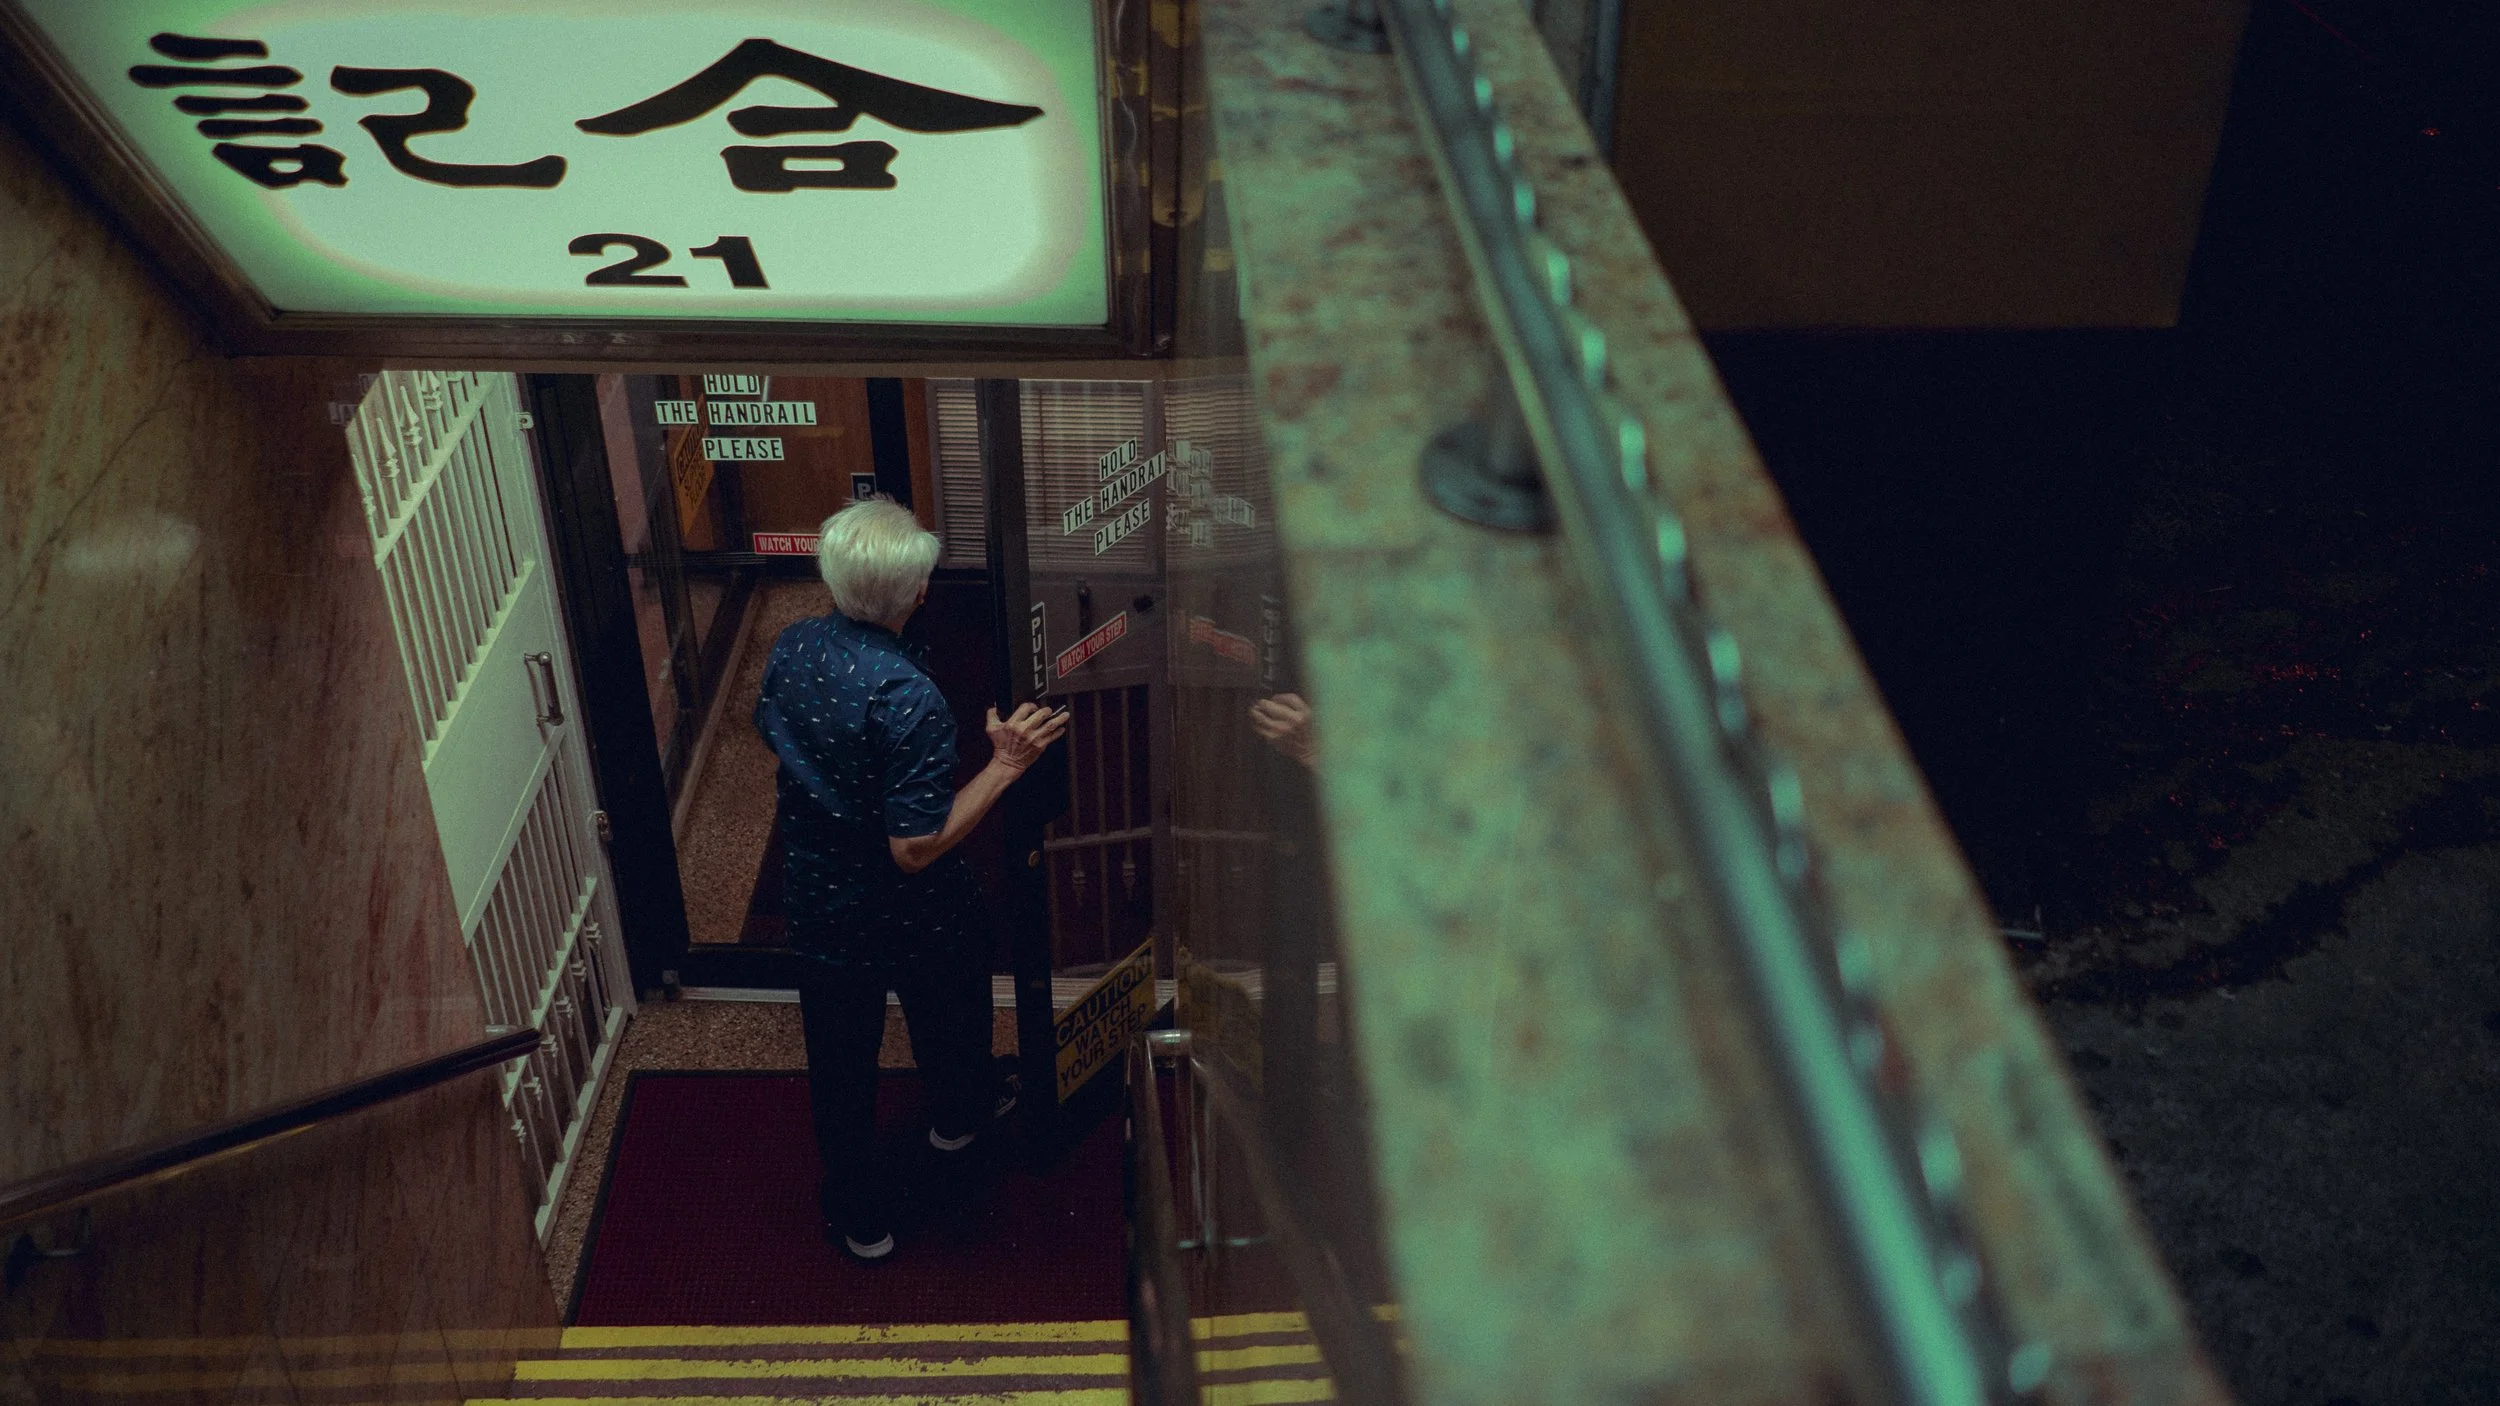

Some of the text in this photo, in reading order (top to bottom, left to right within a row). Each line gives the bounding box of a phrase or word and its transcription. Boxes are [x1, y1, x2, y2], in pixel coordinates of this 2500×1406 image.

[568, 233, 770, 290] 21
[706, 374, 759, 394] HOLD
[656, 402, 815, 424] THE HANDRAIL
[704, 439, 783, 459] PLEASE
[1100, 439, 1136, 479] HOLD
[1064, 497, 1093, 533] THE
[1101, 453, 1162, 511] HANDRAI
[758, 536, 793, 552] WATCH
[1095, 499, 1149, 554] PLEASE
[1031, 615, 1045, 691] PULL
[1059, 620, 1124, 673] WATCH YOUR STEP
[1055, 954, 1151, 1048] CAUTION
[1074, 994, 1131, 1055] WATCH
[1059, 1039, 1105, 1087] YOUR
